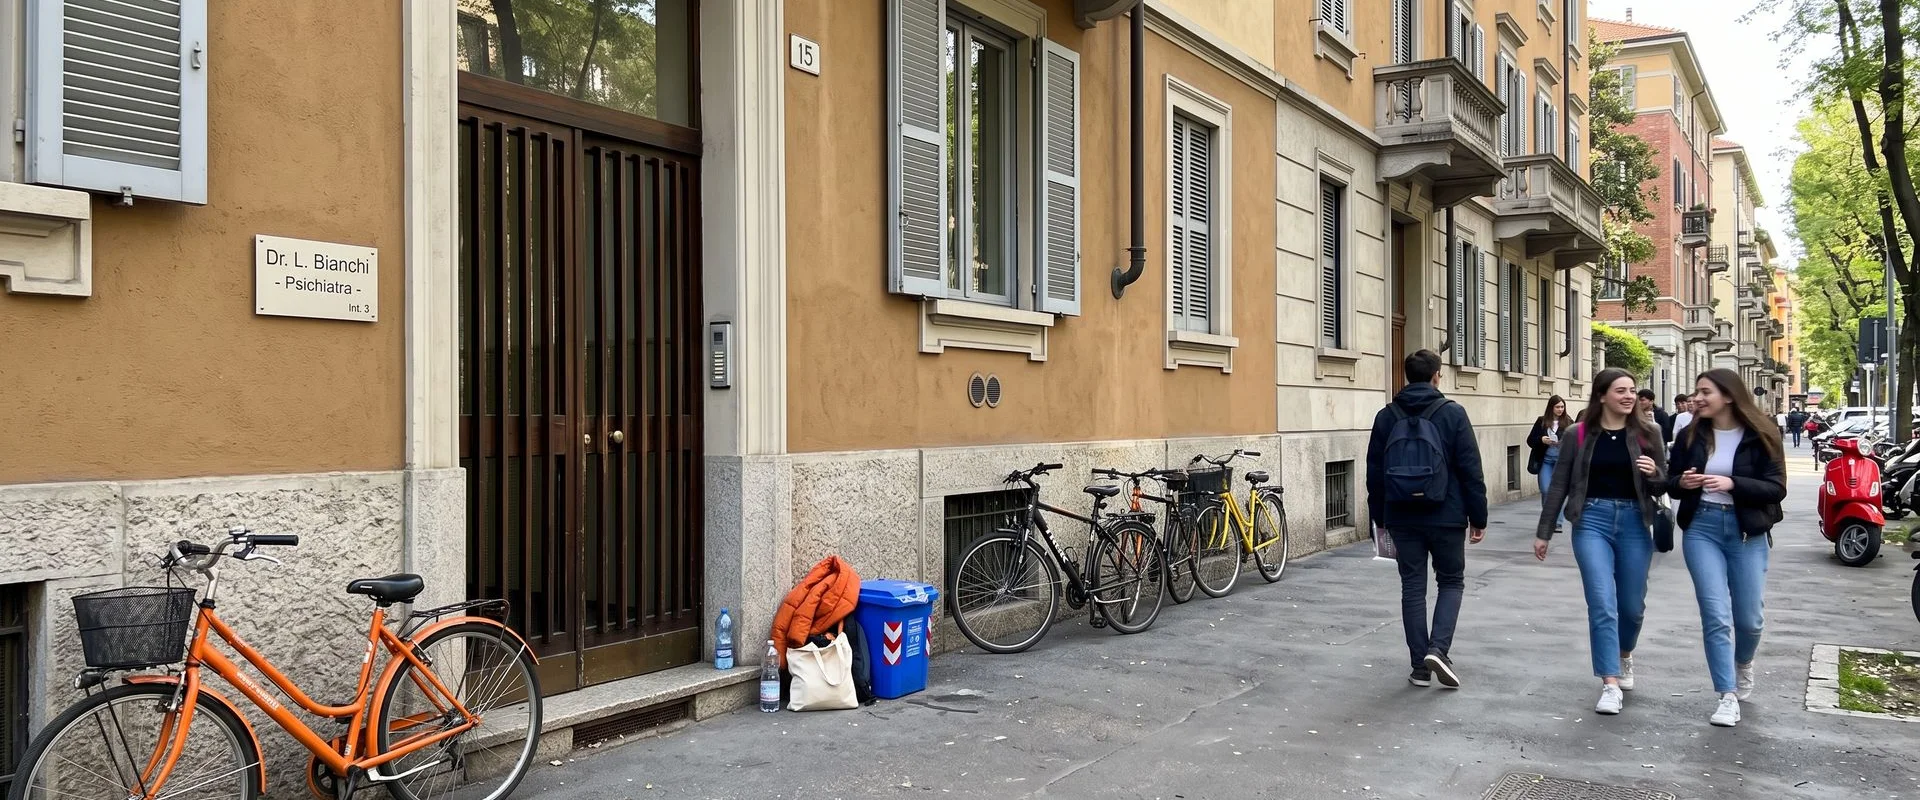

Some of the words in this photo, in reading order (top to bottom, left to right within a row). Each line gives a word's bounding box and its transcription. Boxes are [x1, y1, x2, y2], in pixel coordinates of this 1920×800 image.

[799, 43, 812, 66] 15
[266, 249, 288, 266] Dr.
[294, 252, 308, 269] L.
[314, 253, 369, 274] Bianchi
[285, 276, 352, 295] Psichiatra
[348, 303, 362, 313] Int.
[364, 304, 370, 314] 3
